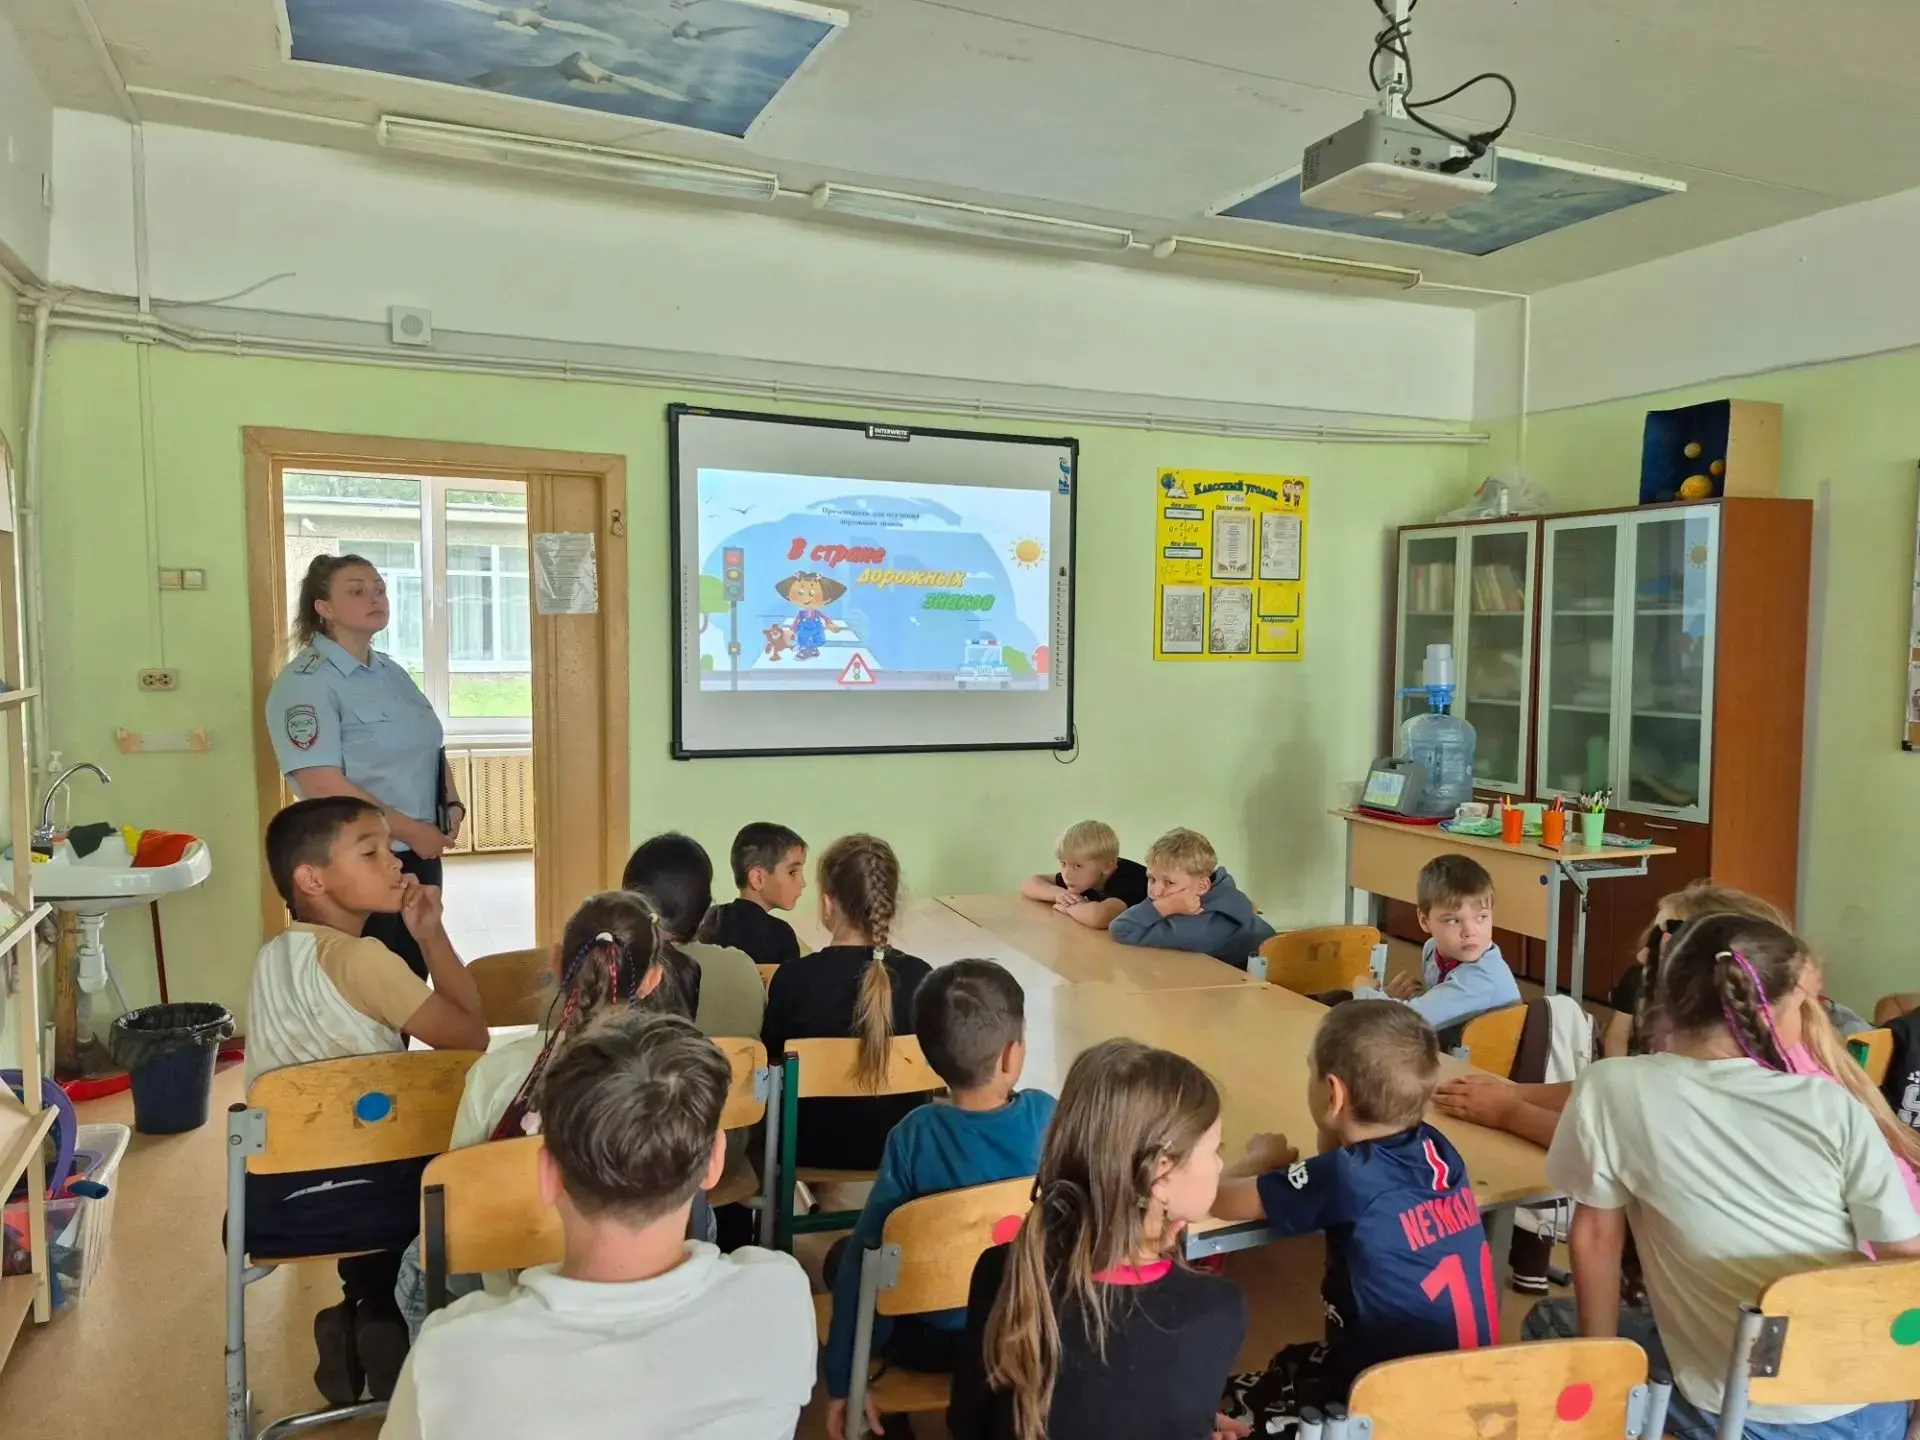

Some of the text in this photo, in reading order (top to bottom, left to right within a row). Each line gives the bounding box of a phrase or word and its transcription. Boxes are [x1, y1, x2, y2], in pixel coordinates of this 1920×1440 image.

[787, 538, 886, 568] В стране
[923, 593, 995, 611] знаков
